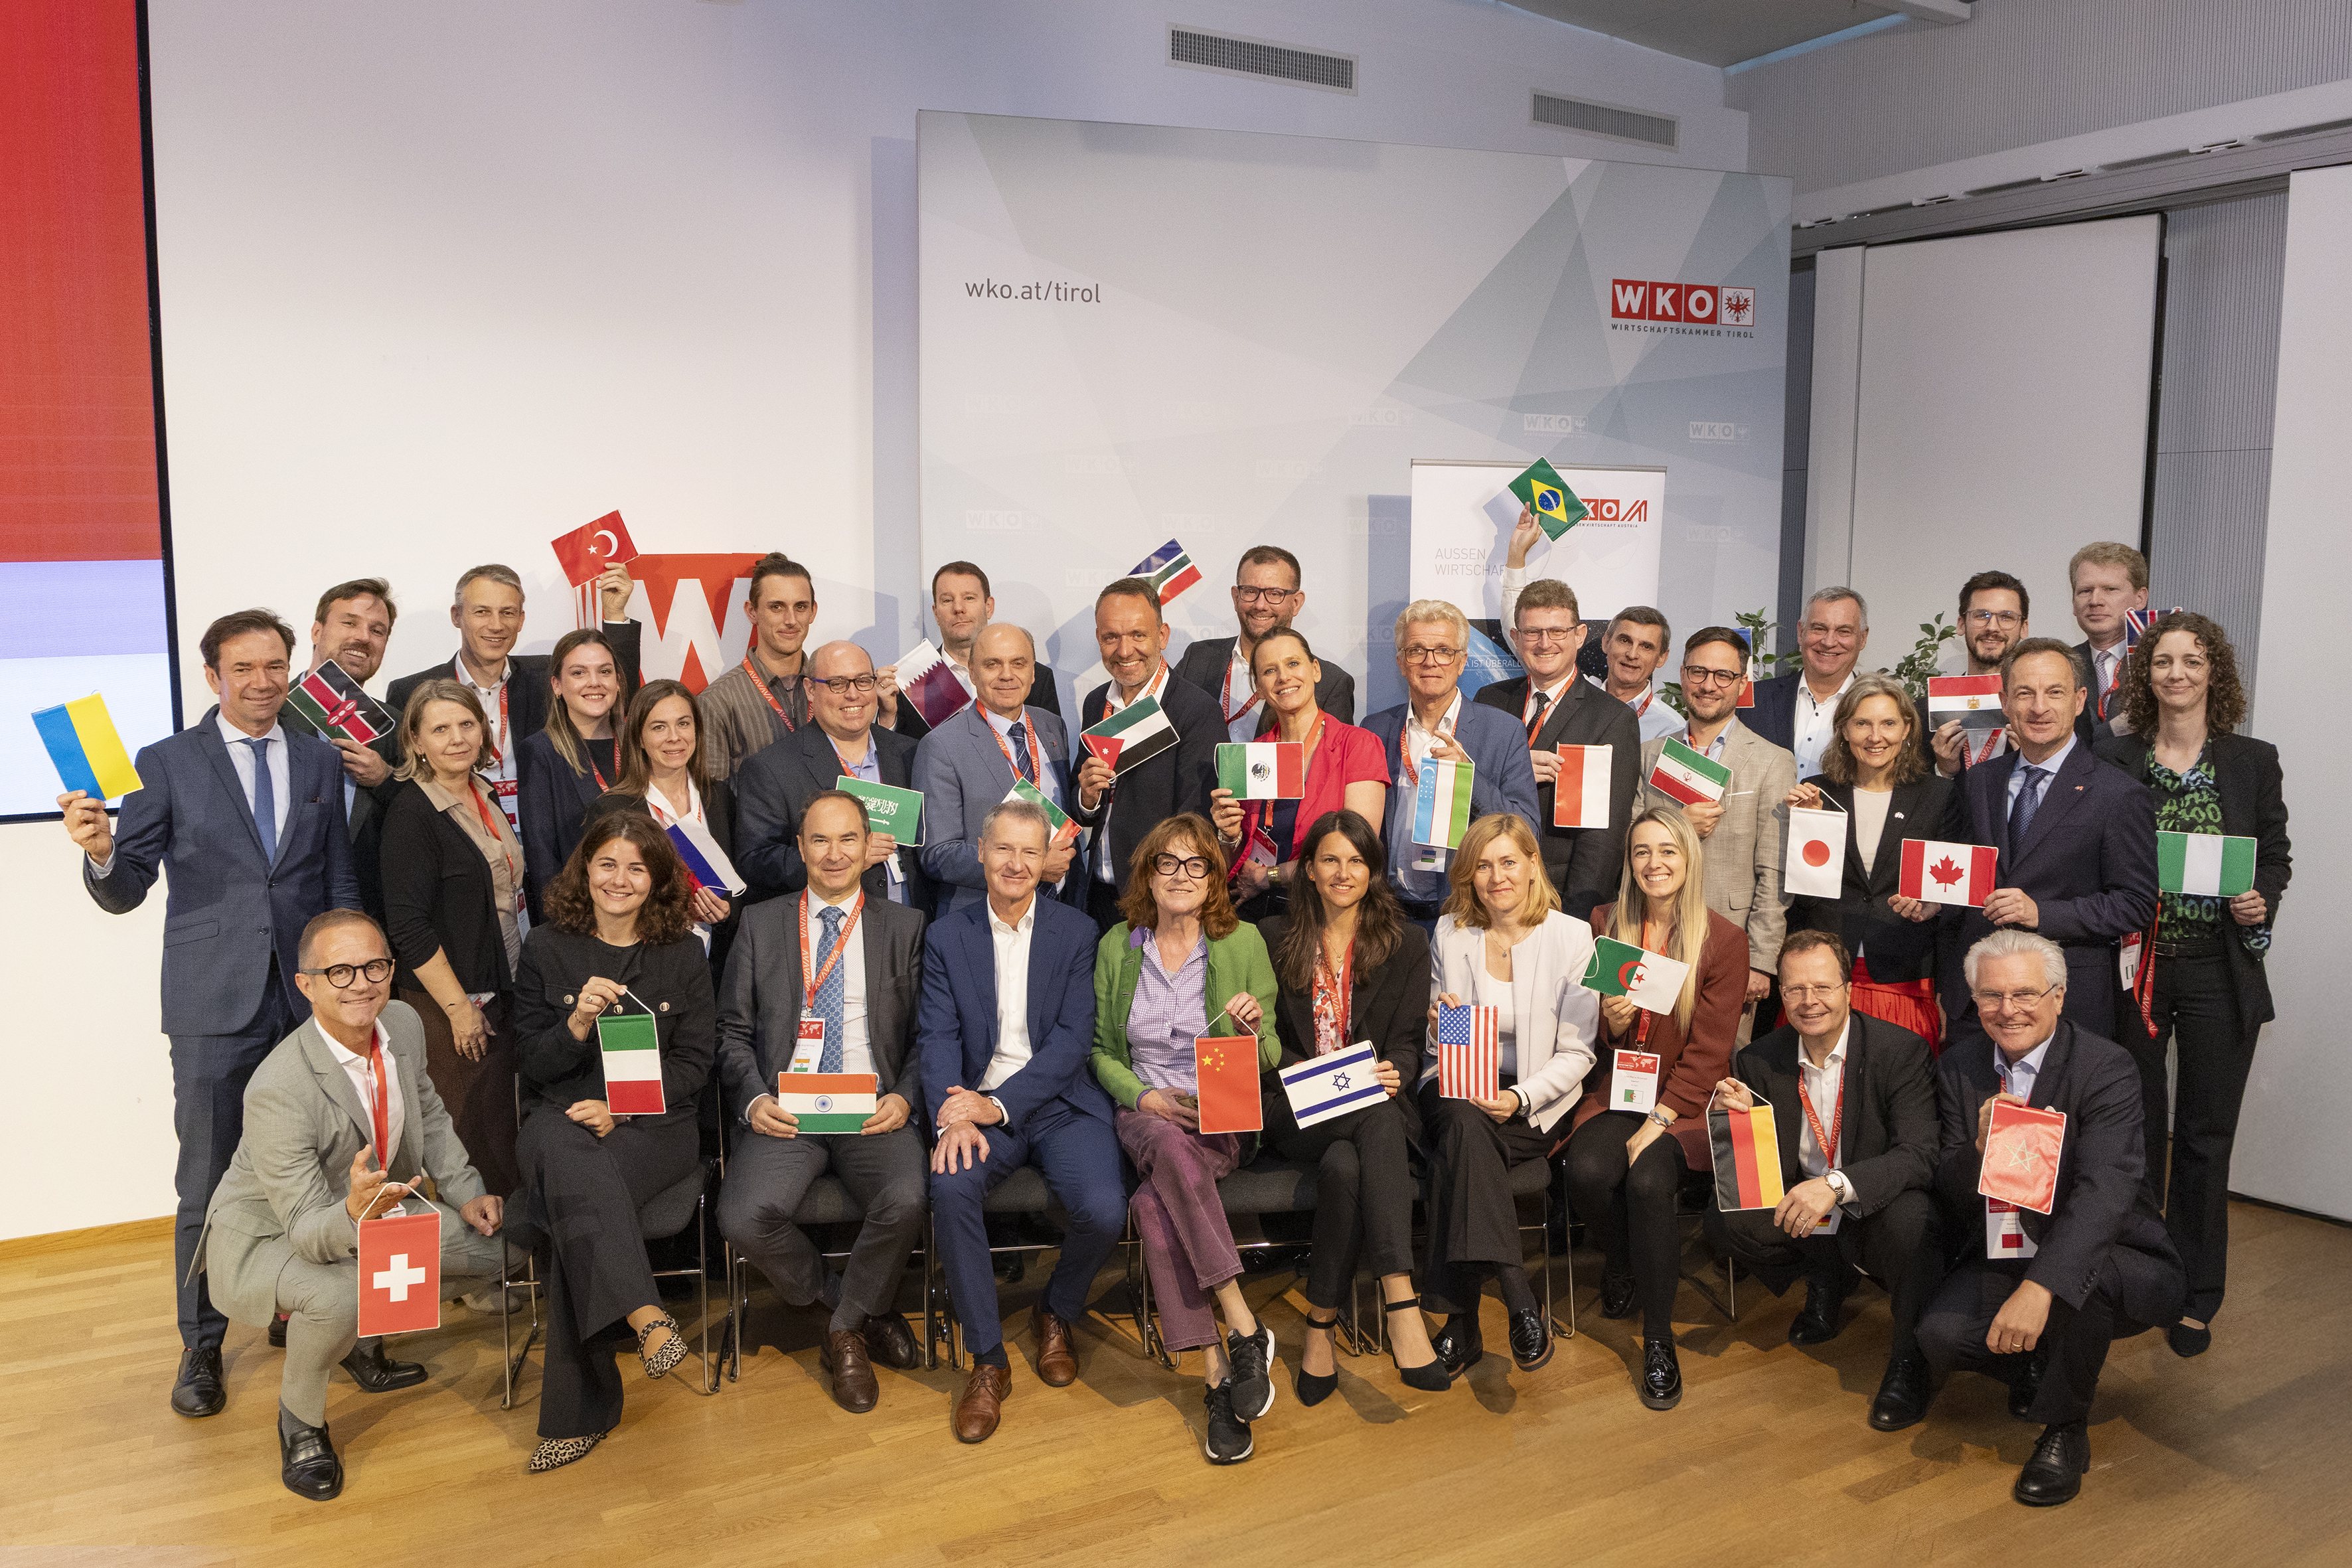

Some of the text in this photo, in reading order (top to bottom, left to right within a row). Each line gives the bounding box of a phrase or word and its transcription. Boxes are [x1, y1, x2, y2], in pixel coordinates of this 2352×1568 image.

[965, 278, 1101, 303] wko.at/tirol
[1613, 282, 1715, 321] WKO
[1611, 323, 1755, 339] WIRTSCHAFTSKAMMER TIROL
[1526, 415, 1570, 431] WKO
[1691, 423, 1733, 438] WKO
[1435, 548, 1486, 560] AUSSEN
[1435, 564, 1505, 576] WIRTSCHAF
[1486, 657, 1522, 667] ÜBERALL
